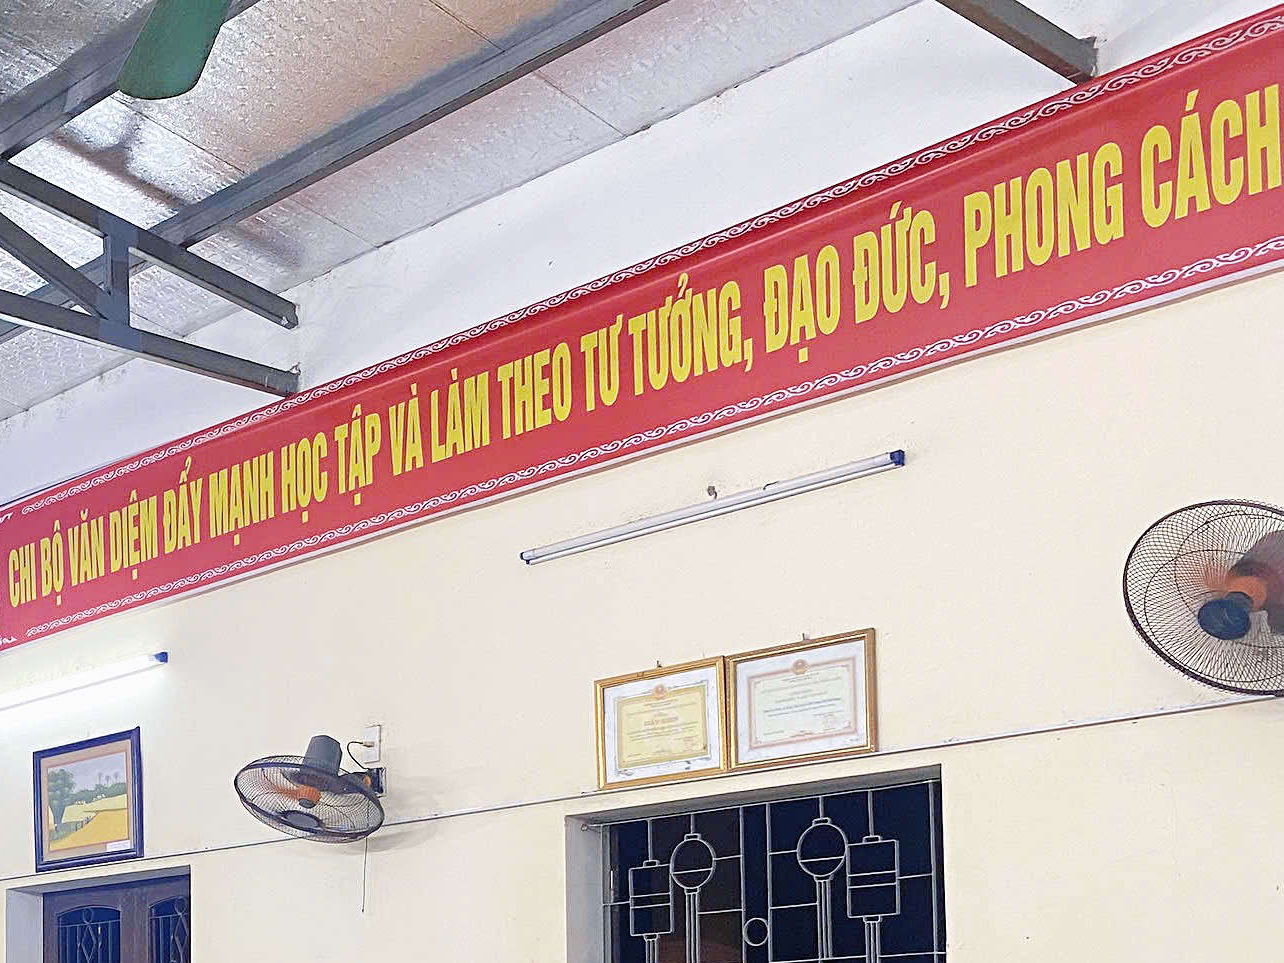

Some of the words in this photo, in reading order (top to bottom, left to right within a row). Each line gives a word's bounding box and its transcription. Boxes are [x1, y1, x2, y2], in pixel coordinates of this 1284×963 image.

[7, 541, 38, 607] CHI
[40, 525, 65, 607] BỘ
[68, 508, 105, 582] VĂN
[109, 489, 157, 580] DIỆM
[162, 456, 203, 553] ĐẨY
[209, 450, 276, 546] MẠNH
[280, 431, 329, 523] HỌC
[334, 403, 381, 505] TẬP
[388, 382, 424, 477] VÀ
[431, 366, 490, 462] LÀM
[497, 343, 572, 440] THEO
[580, 315, 622, 411] TƯ
[628, 273, 753, 397] TƯỞNG,
[763, 245, 842, 363] ĐẠO
[852, 201, 950, 324] ĐỨC,
[964, 143, 1124, 288] PHONG
[1140, 84, 1283, 229] CÁCH
